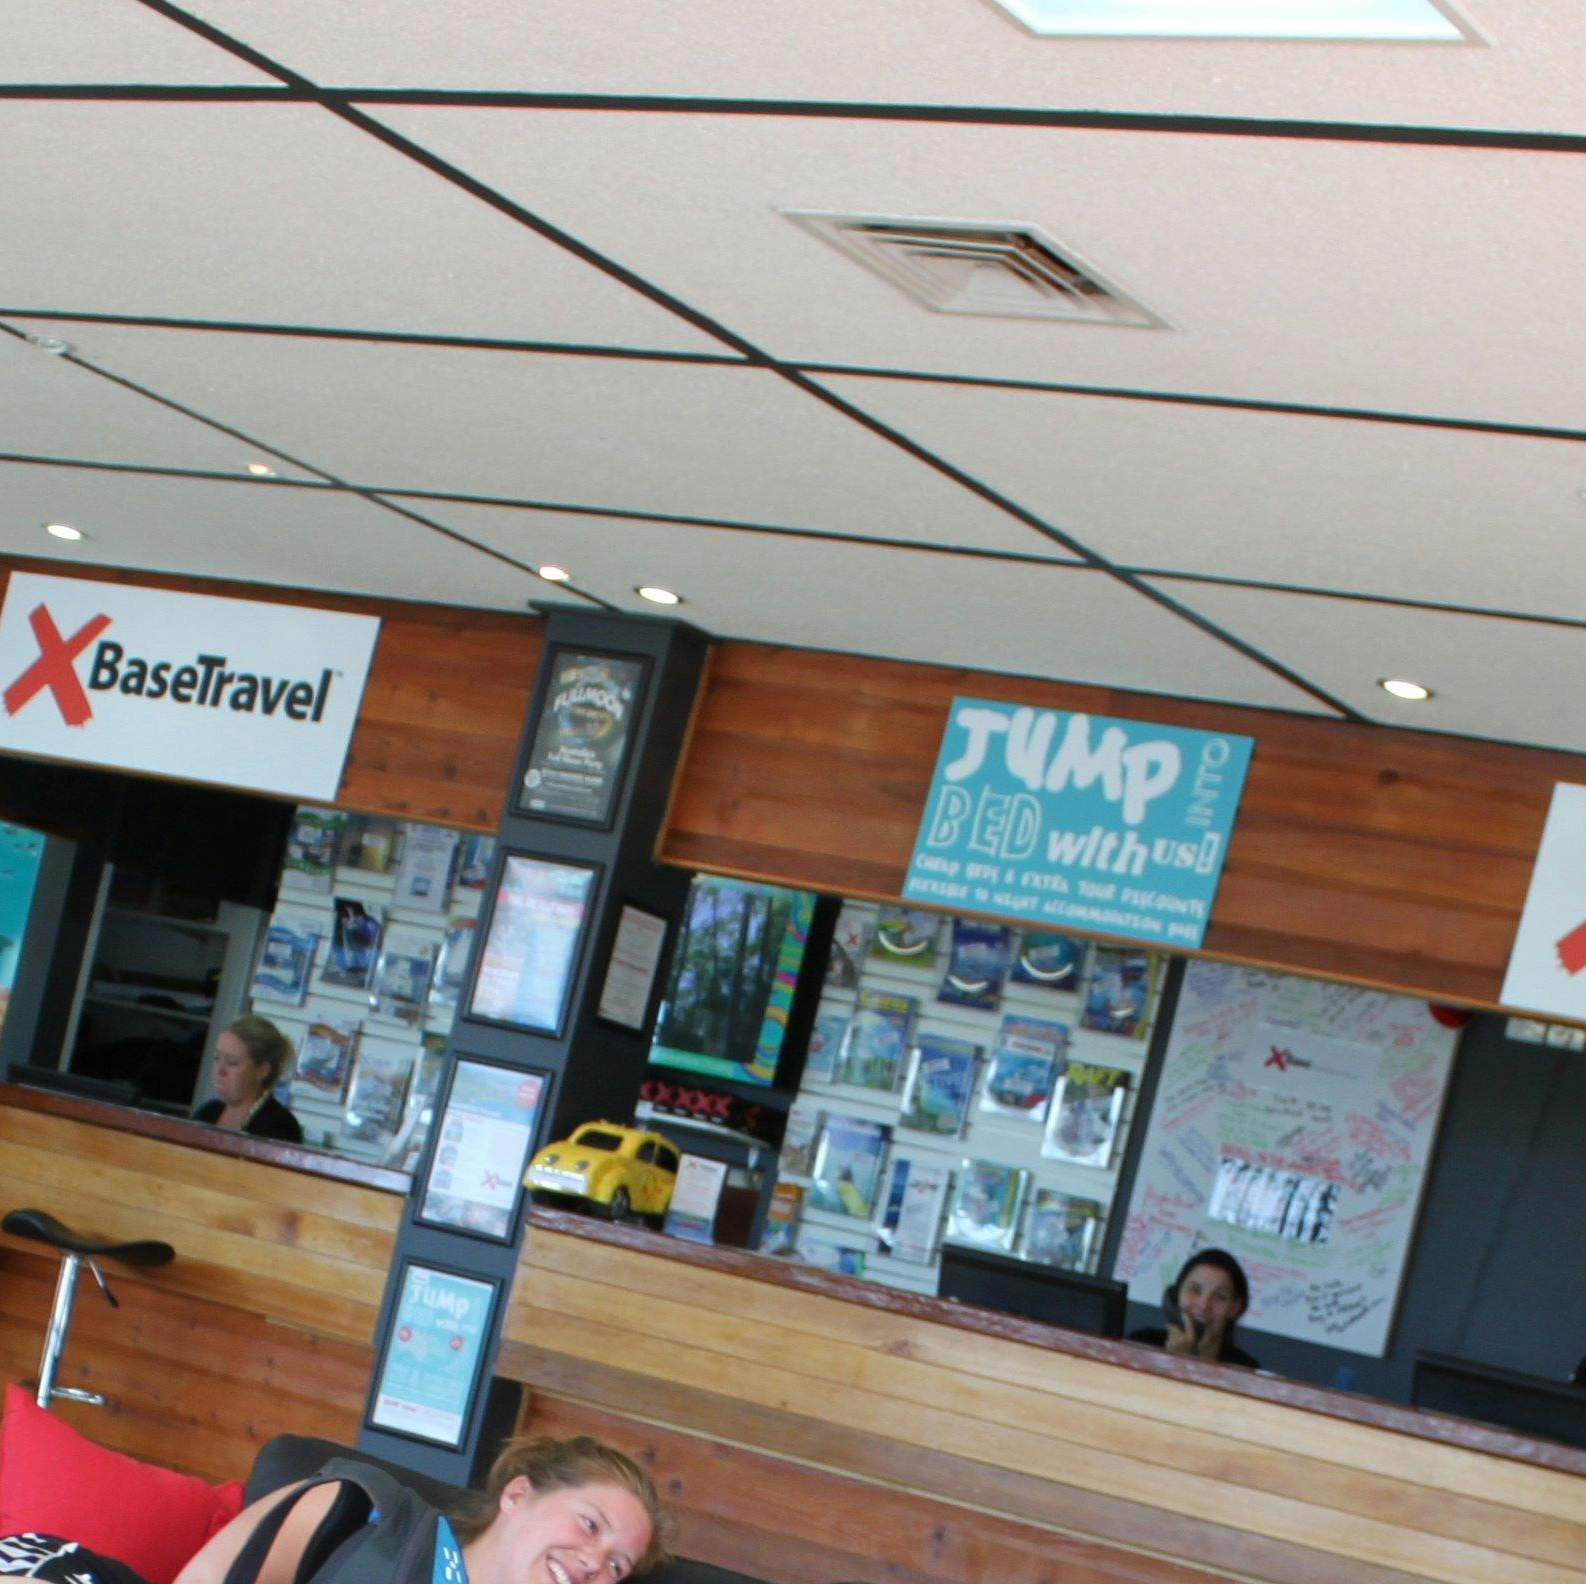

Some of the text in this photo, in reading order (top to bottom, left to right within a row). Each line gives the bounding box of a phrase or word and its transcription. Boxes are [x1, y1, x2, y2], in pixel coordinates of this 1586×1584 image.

[944, 707, 1231, 827] JUMP INTO
[925, 784, 1043, 861] BED
